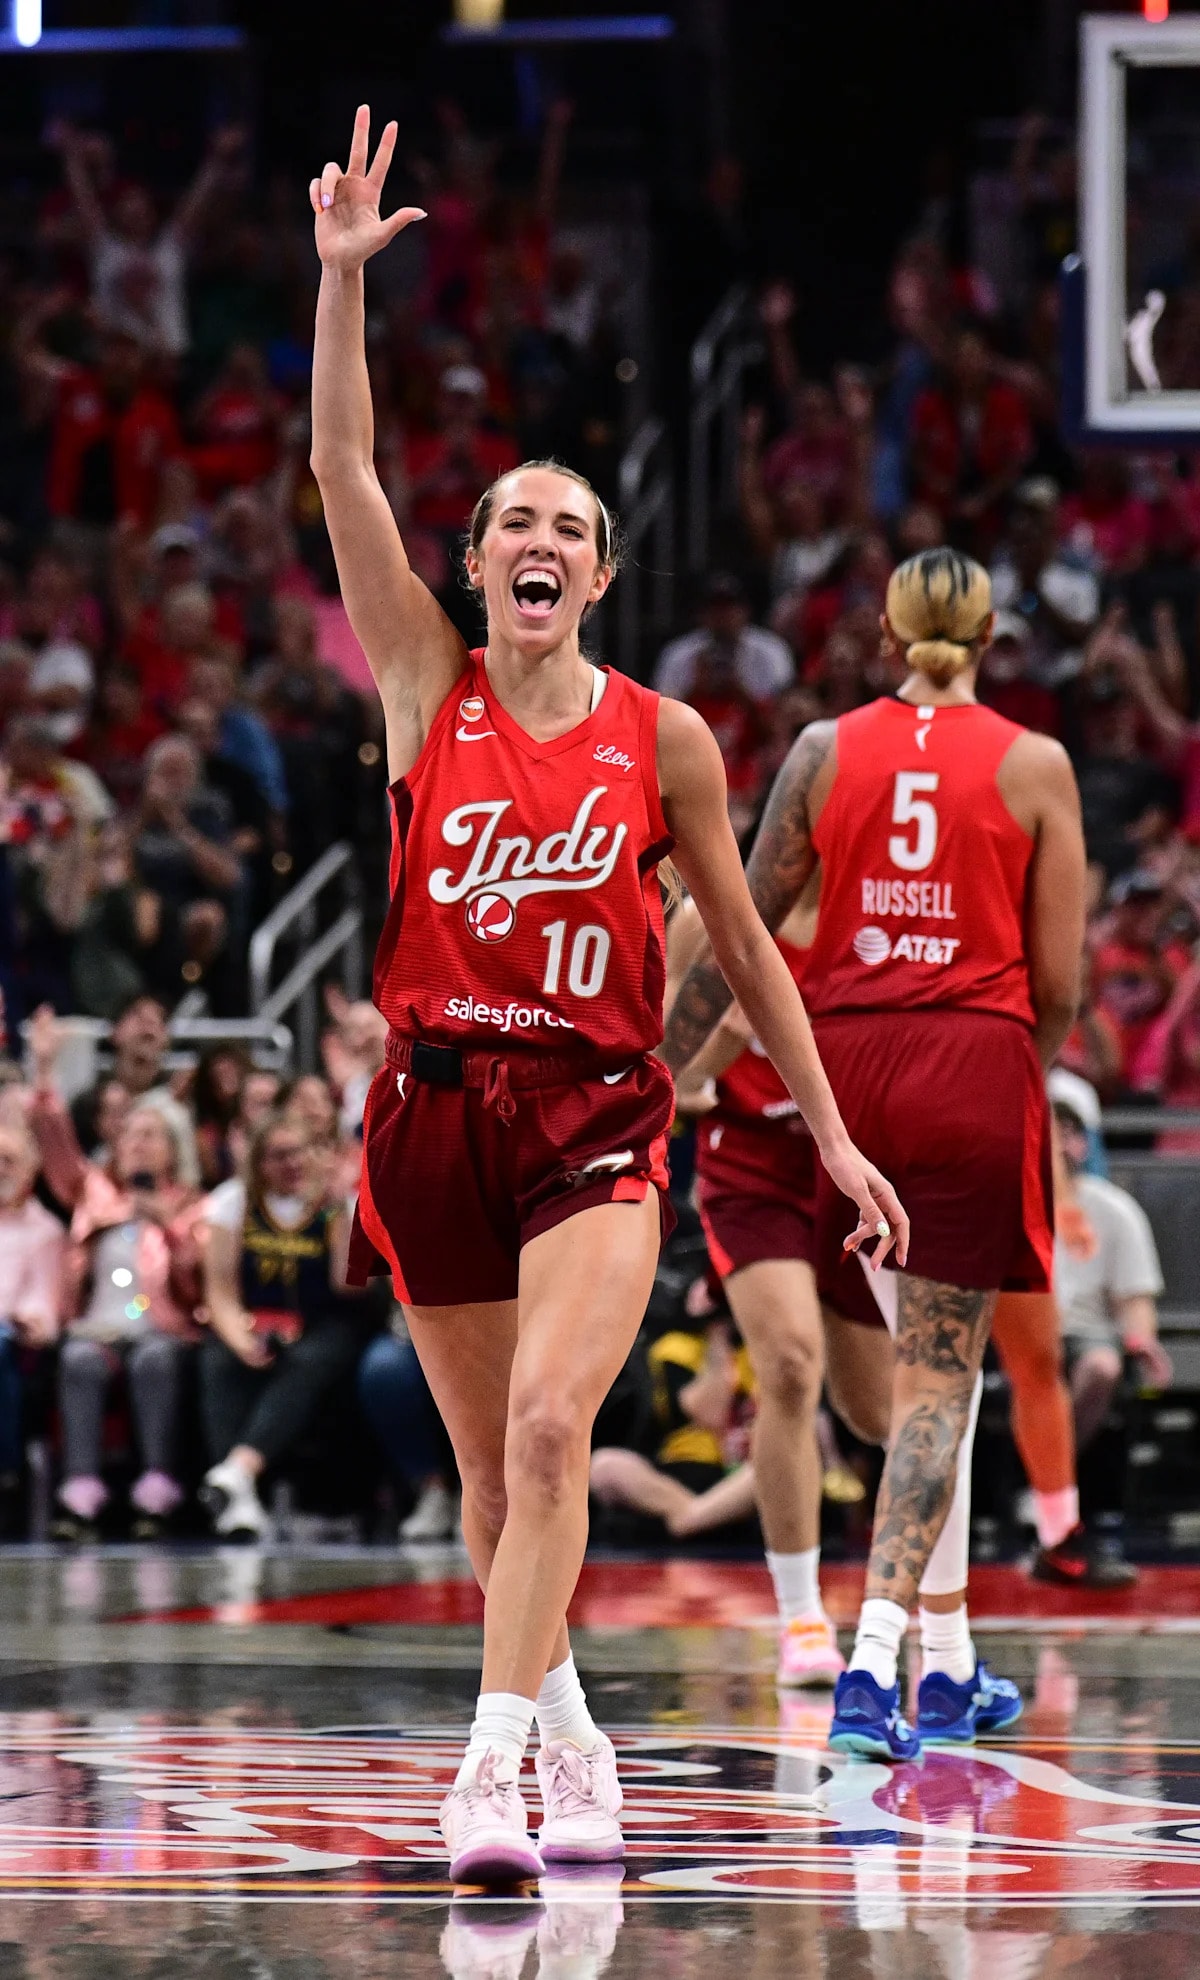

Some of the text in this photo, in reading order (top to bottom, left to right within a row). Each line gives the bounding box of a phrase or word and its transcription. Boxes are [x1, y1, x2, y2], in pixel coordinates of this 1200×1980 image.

[592, 744, 636, 773] Lilly
[428, 785, 628, 907] Indy
[888, 771, 939, 871] 5
[862, 878, 957, 919] RUSSELL
[541, 919, 611, 998] 10
[891, 933, 961, 965] AT&T
